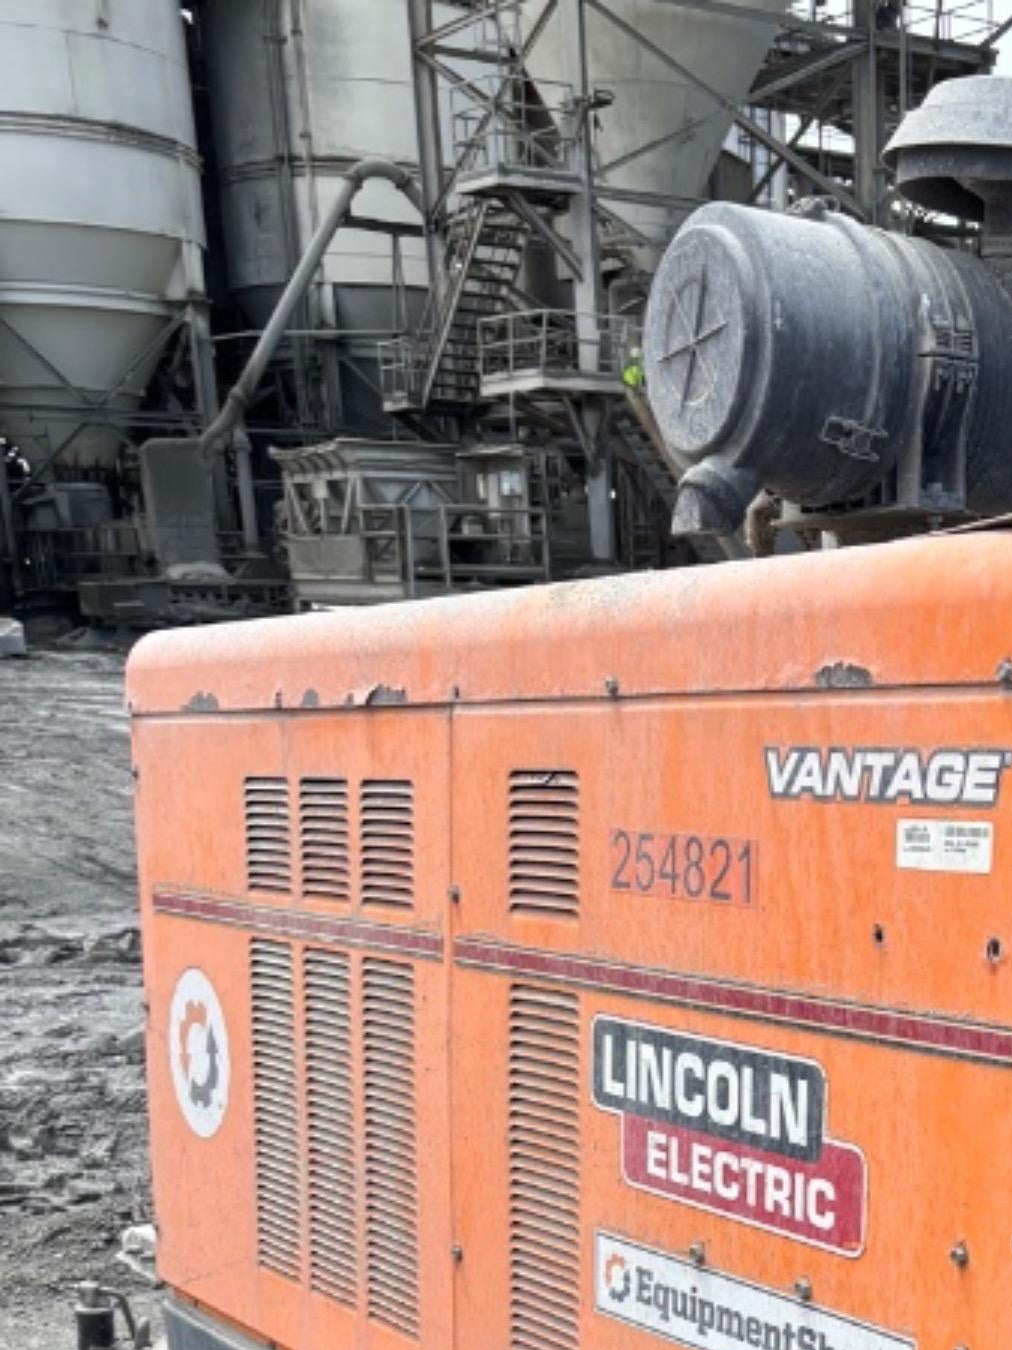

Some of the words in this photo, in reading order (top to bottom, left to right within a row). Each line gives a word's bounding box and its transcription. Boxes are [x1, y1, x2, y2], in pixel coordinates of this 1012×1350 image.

[764, 746, 1002, 808] VANTAGE
[611, 830, 752, 903] 254821
[602, 1034, 808, 1147] LINCOLN
[646, 1131, 835, 1231] ELECTRIC
